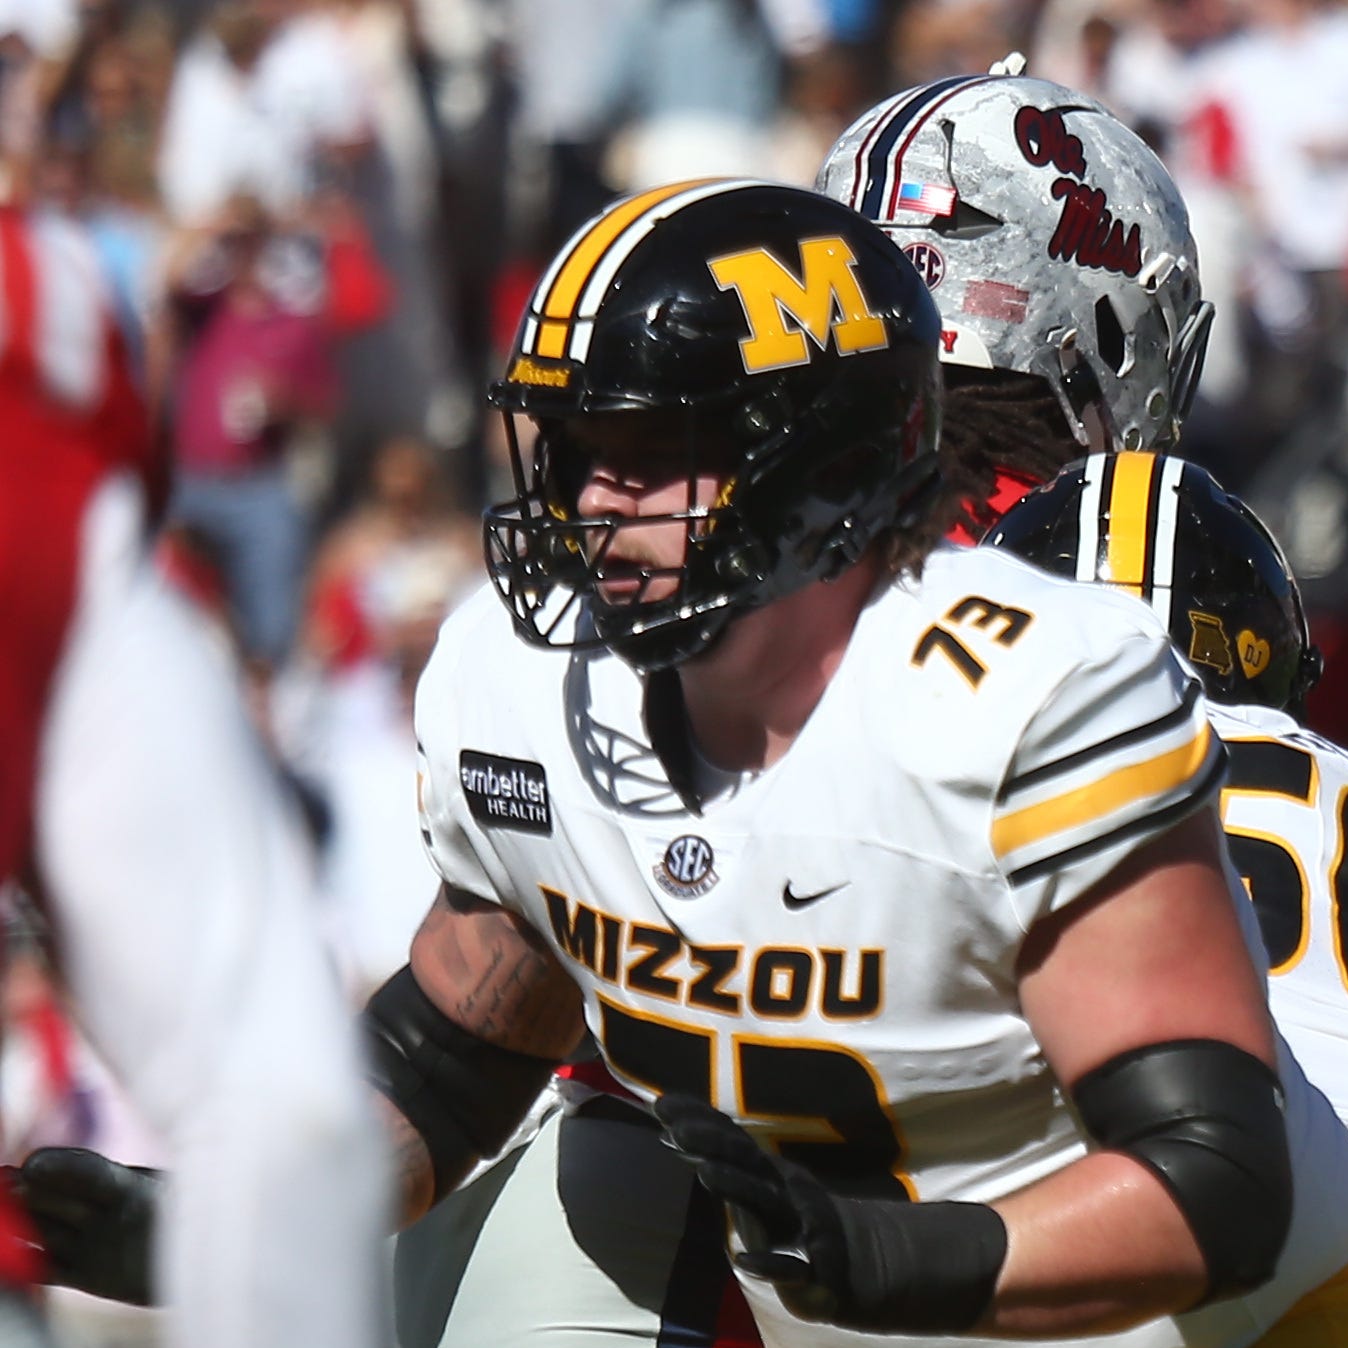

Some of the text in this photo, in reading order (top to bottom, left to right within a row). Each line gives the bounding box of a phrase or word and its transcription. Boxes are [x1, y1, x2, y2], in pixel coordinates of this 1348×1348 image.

[1014, 105, 1088, 181] Ole
[1047, 177, 1142, 278] Miss
[708, 236, 889, 374] M
[909, 595, 1035, 693] 73
[1244, 644, 1262, 667] DJ
[461, 764, 546, 805] ambetter
[487, 798, 548, 823] HEALTH
[667, 836, 711, 883] SEC
[537, 882, 886, 1023] MIZZOU
